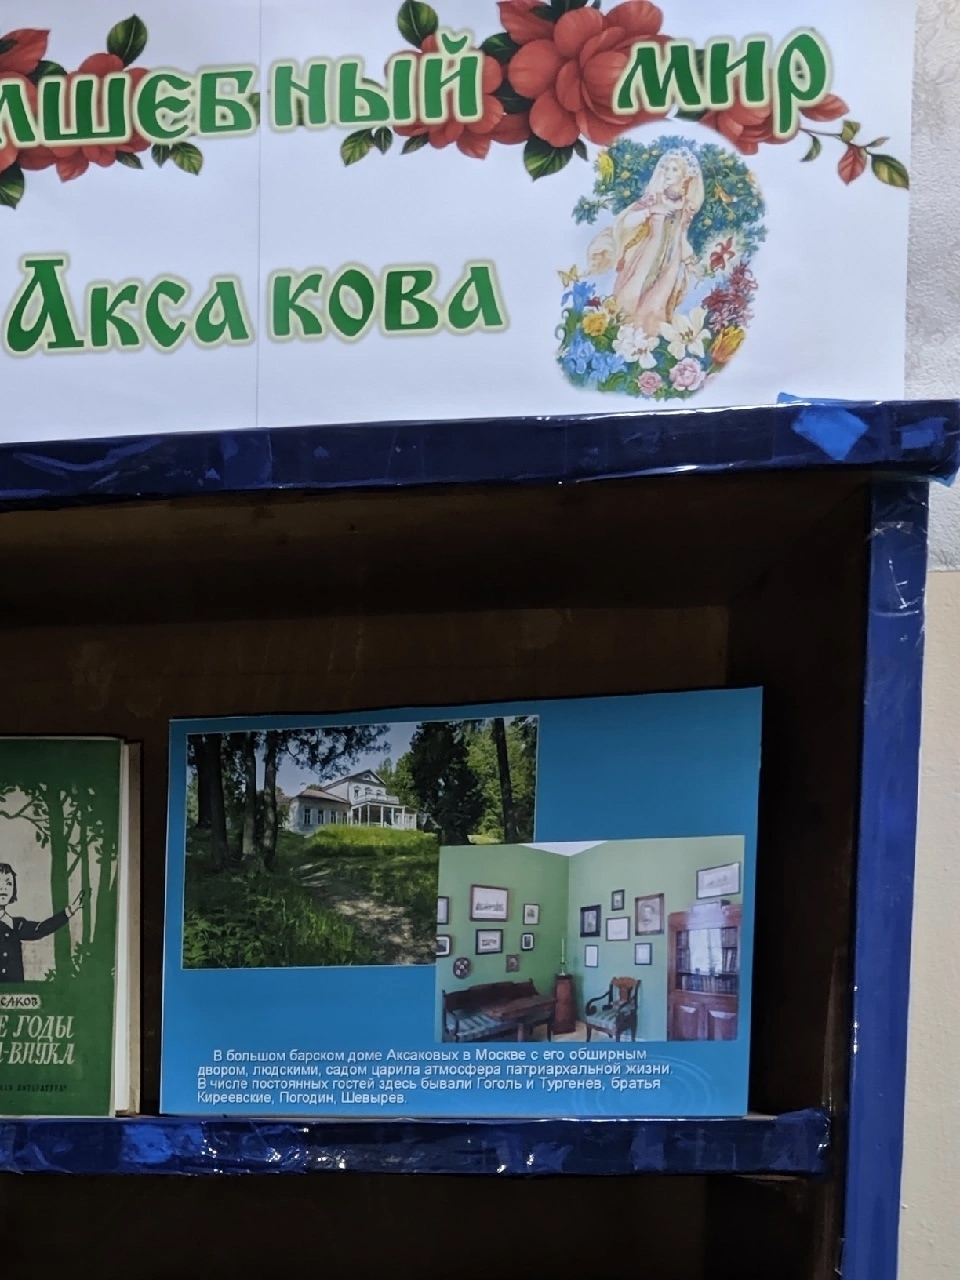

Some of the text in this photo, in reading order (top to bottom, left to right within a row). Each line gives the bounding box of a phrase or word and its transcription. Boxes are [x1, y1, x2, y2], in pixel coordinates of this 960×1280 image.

[614, 36, 828, 136] мир
[3, 257, 507, 354] Аксакова
[12, 1013, 74, 1039] ГОДЫ
[213, 1049, 222, 1061] В
[226, 1048, 285, 1061] большом
[289, 1049, 345, 1064] барском
[348, 1050, 382, 1063] доме
[386, 1048, 458, 1061] Аксаковых
[475, 1048, 526, 1061] Москве
[543, 1051, 565, 1061] его
[569, 1047, 647, 1063] обширным
[197, 1062, 673, 1078] двором, людскими, садом царила атмосфера патриархальной жизни.
[197, 1078, 206, 1090] В
[210, 1079, 248, 1090] числе
[252, 1079, 328, 1090] постоянных
[332, 1077, 375, 1090] гостей
[379, 1078, 416, 1091] здесь
[420, 1077, 472, 1090] бывали
[477, 1076, 523, 1090] Гоголь
[540, 1076, 605, 1091] Тургенев,
[611, 1076, 661, 1091] братья
[197, 1091, 407, 1105] Киреевские, Погодин, Шевырев.
